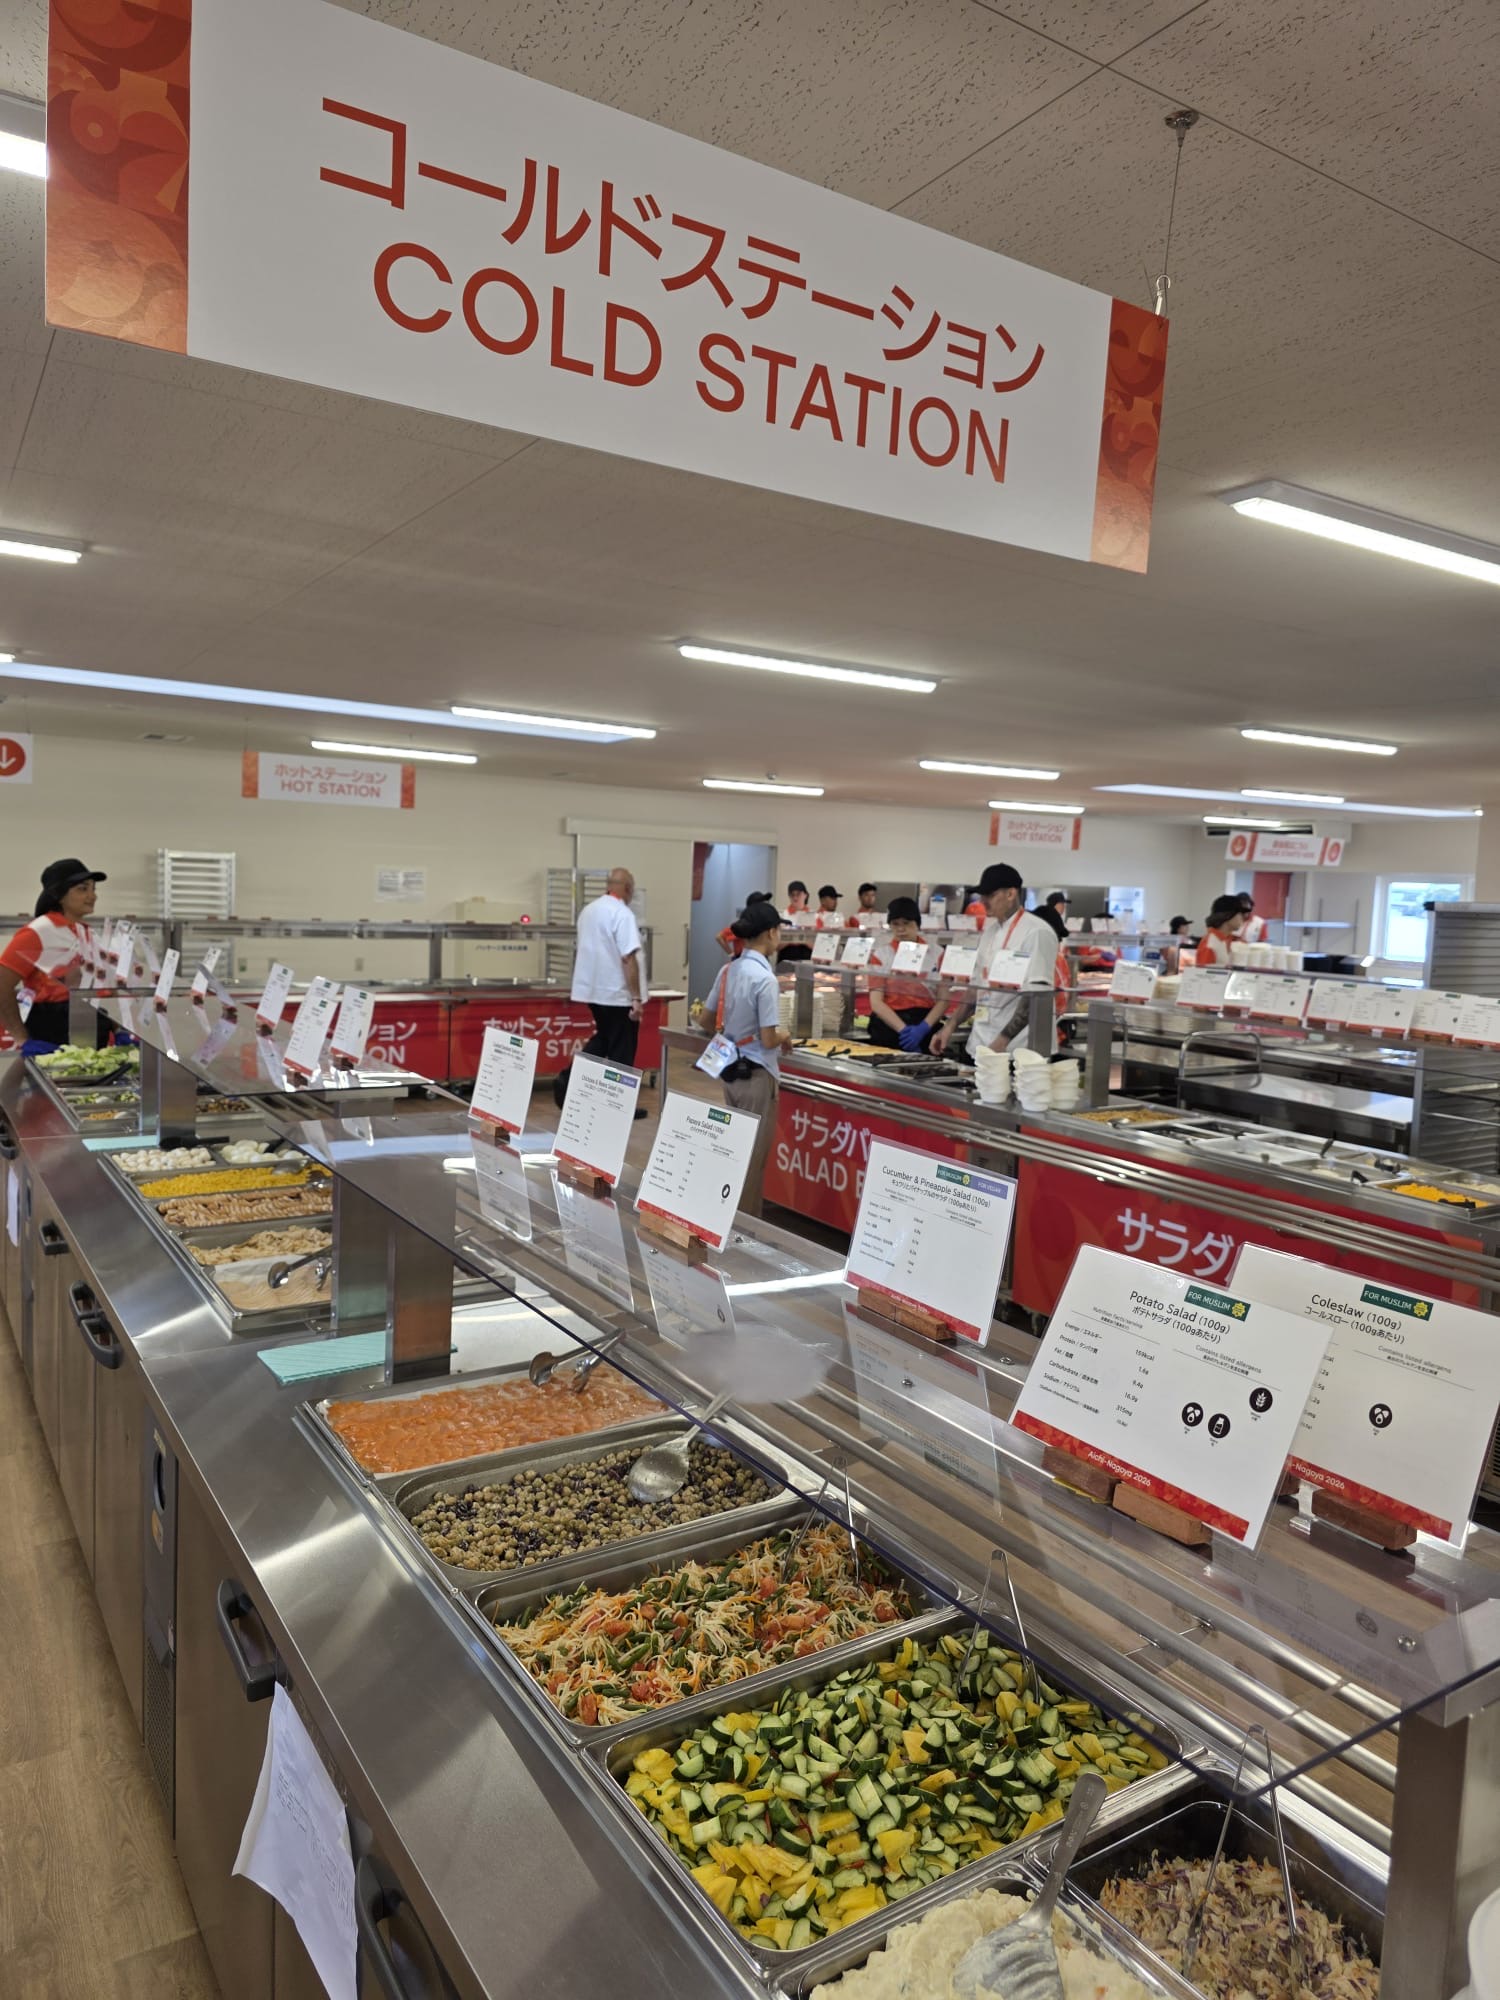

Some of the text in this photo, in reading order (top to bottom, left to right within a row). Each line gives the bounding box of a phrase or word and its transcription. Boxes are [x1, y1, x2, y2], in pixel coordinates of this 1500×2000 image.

[320, 97, 1044, 393] コールドステーション
[374, 242, 1009, 484] COLD STATION
[275, 764, 387, 784] ホットステーション
[281, 780, 381, 798] HOT STATION
[1009, 832, 1062, 844] HOT STATION
[791, 1109, 870, 1163] サラダバ
[777, 1143, 848, 1192] SALAD
[882, 1166, 913, 1182] Cucumber
[921, 1177, 951, 1194] Pineapple
[953, 1188, 971, 1201] Salad
[972, 1196, 991, 1209] (100g)
[1117, 1208, 1235, 1280] サラダ
[1130, 1290, 1231, 1334] Potato Salad (100g)
[1188, 1291, 1231, 1311] FOR MUSLIM
[1311, 1294, 1402, 1331] Coleslaw (100g)
[1363, 1290, 1412, 1310] FOR MUSLIM
[1132, 1306, 1172, 1325] ポテトサラダ
[1172, 1320, 1221, 1344] (100gあたり)
[1304, 1306, 1405, 1345] コールスロー (100gあたり)
[1088, 1451, 1151, 1487] Aichi-Nagoya 2026
[1325, 1475, 1345, 1490] 2026
